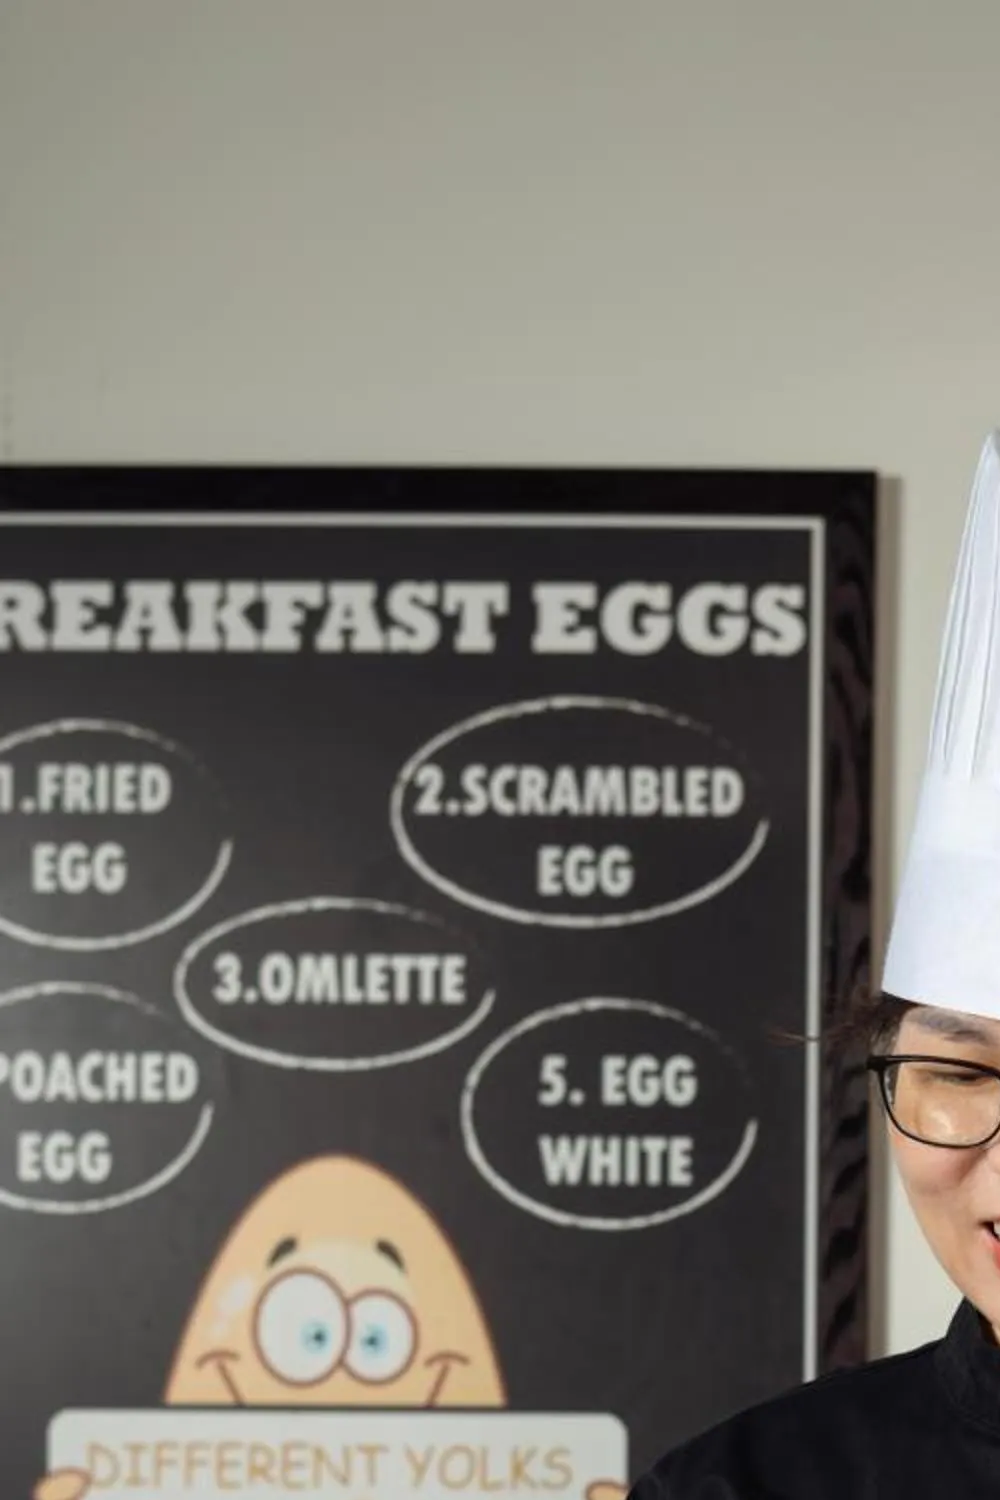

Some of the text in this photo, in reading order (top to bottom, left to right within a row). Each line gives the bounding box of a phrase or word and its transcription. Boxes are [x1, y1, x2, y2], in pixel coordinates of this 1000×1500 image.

[0, 581, 807, 656] REAKFAST EGGS
[0, 763, 173, 814] 1.FRIED
[413, 765, 745, 817] 2.SCRAMBLED
[31, 843, 128, 894] EGG
[536, 846, 635, 897] EGG
[212, 953, 467, 1005] 3.OMLETTE
[538, 1055, 698, 1107] 5. EGG
[16, 1131, 113, 1184] EGG
[539, 1136, 694, 1187] WHITE
[86, 1440, 574, 1492] DIFFERENT YOLKS
